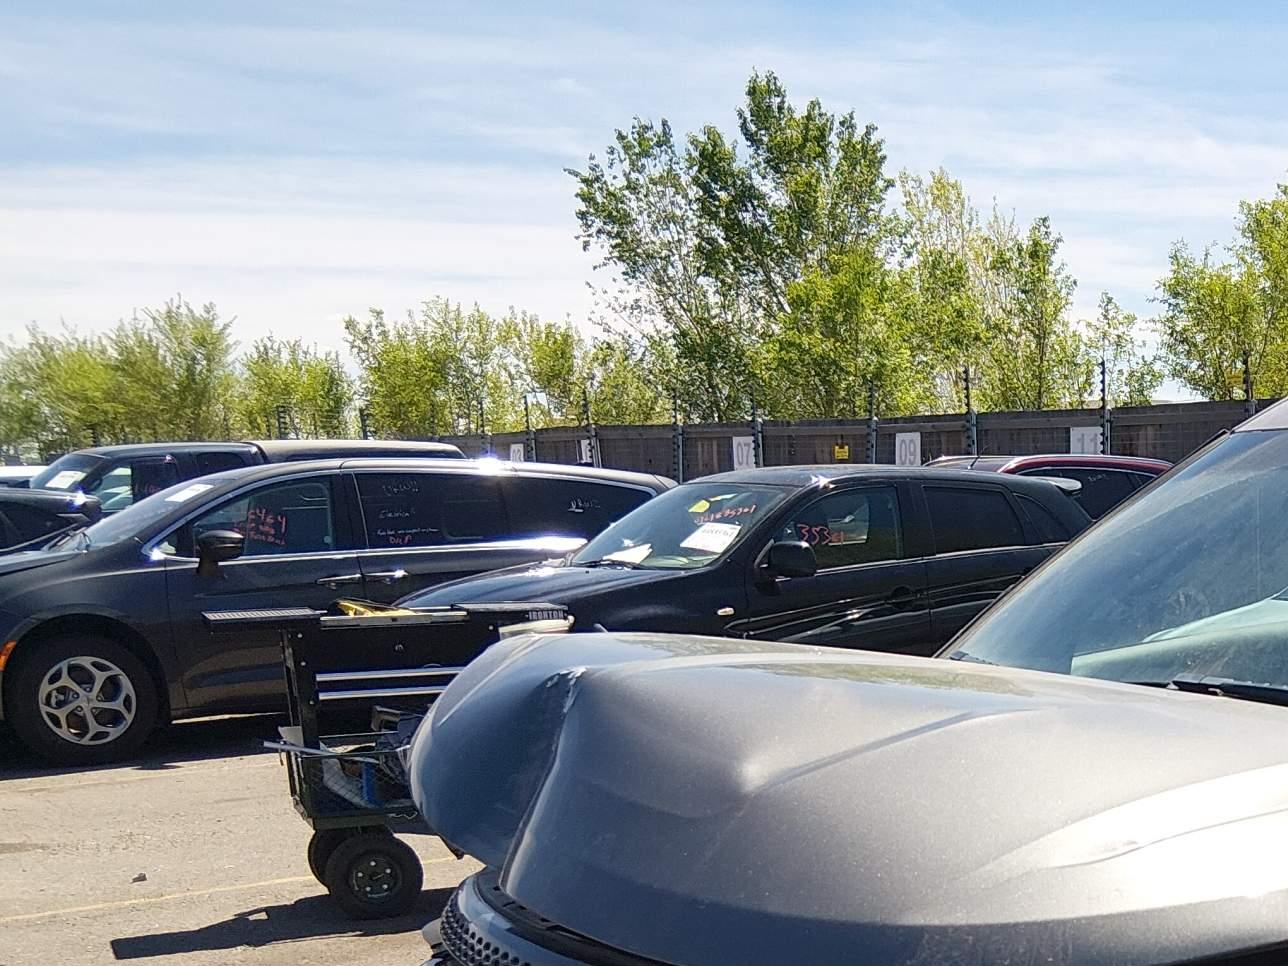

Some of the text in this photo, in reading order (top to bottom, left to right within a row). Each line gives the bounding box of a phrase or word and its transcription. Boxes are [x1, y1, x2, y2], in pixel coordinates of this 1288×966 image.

[736, 441, 752, 466] 07
[899, 438, 916, 466] 09
[528, 609, 565, 621] IRONTON
